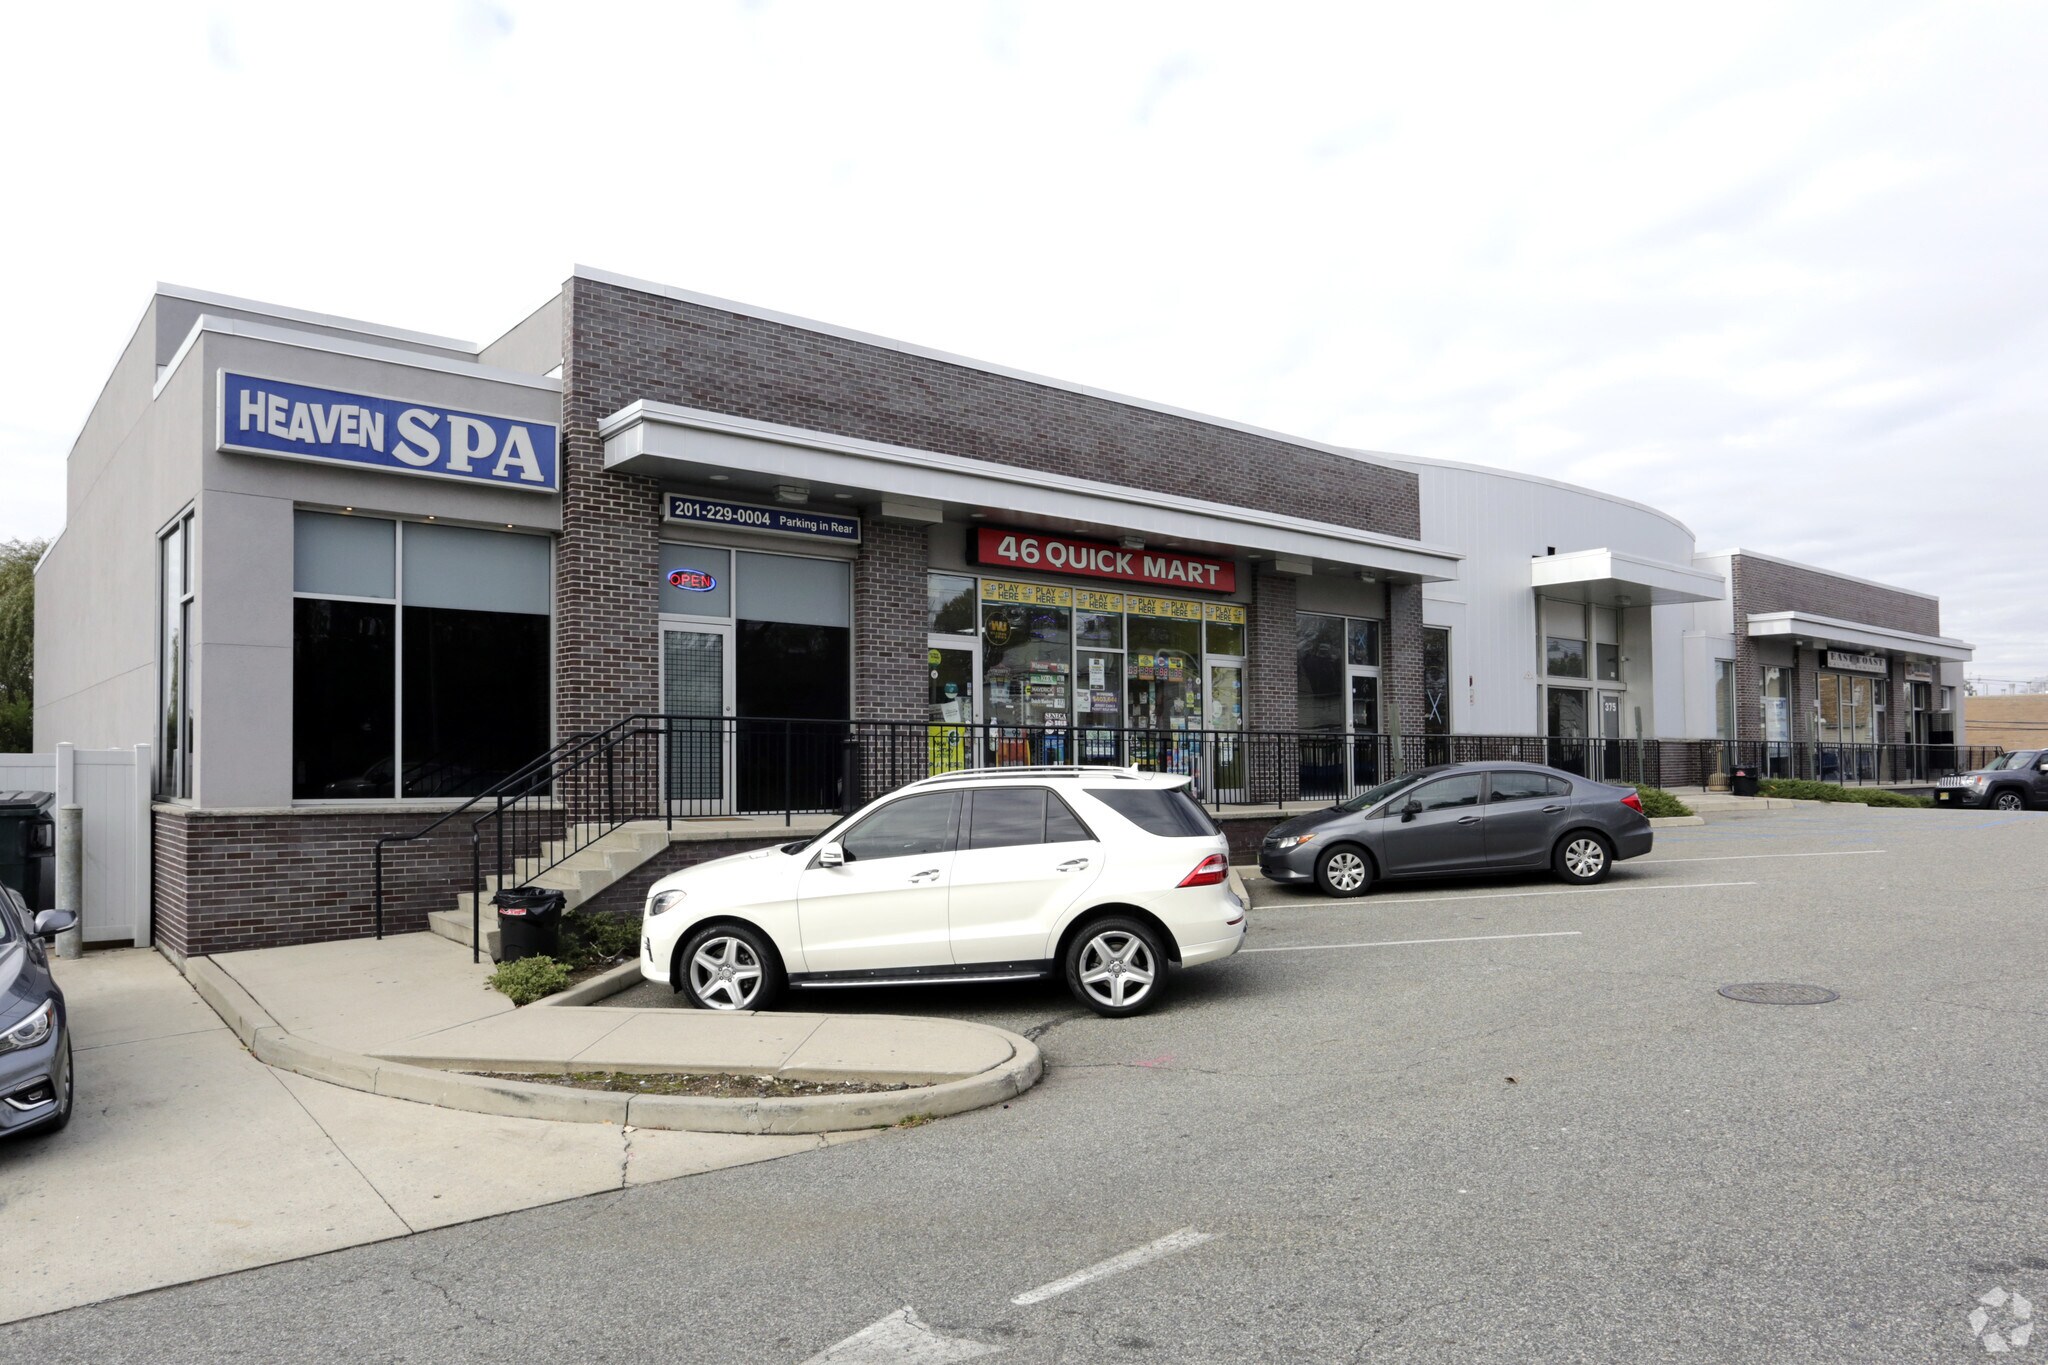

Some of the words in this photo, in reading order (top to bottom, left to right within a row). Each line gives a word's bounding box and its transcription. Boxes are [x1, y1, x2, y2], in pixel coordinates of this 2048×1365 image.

[240, 389, 384, 453] HEAVEN
[391, 408, 545, 482] SPA
[675, 501, 770, 526] 201-229-0004
[779, 515, 817, 532] Parking
[819, 520, 829, 531] in
[831, 522, 854, 534] Rear
[997, 536, 1040, 564] 46
[1046, 542, 1134, 575] QUICK
[1143, 555, 1220, 585] MART
[670, 574, 712, 587] OPEN
[997, 583, 1019, 593] PLAY
[1036, 587, 1056, 596] PLAY
[998, 592, 1019, 600] HERE
[1036, 595, 1056, 604] HERE
[1089, 593, 1108, 602] PLAY
[1089, 601, 1108, 610] HERE
[1138, 598, 1156, 607] PLAY
[1171, 601, 1188, 610] PLAY
[1138, 606, 1156, 615] HERE
[1171, 609, 1188, 617] HERE
[1215, 606, 1232, 614] PLAY
[1216, 613, 1232, 621] HERE
[1604, 702, 1617, 712] 375
